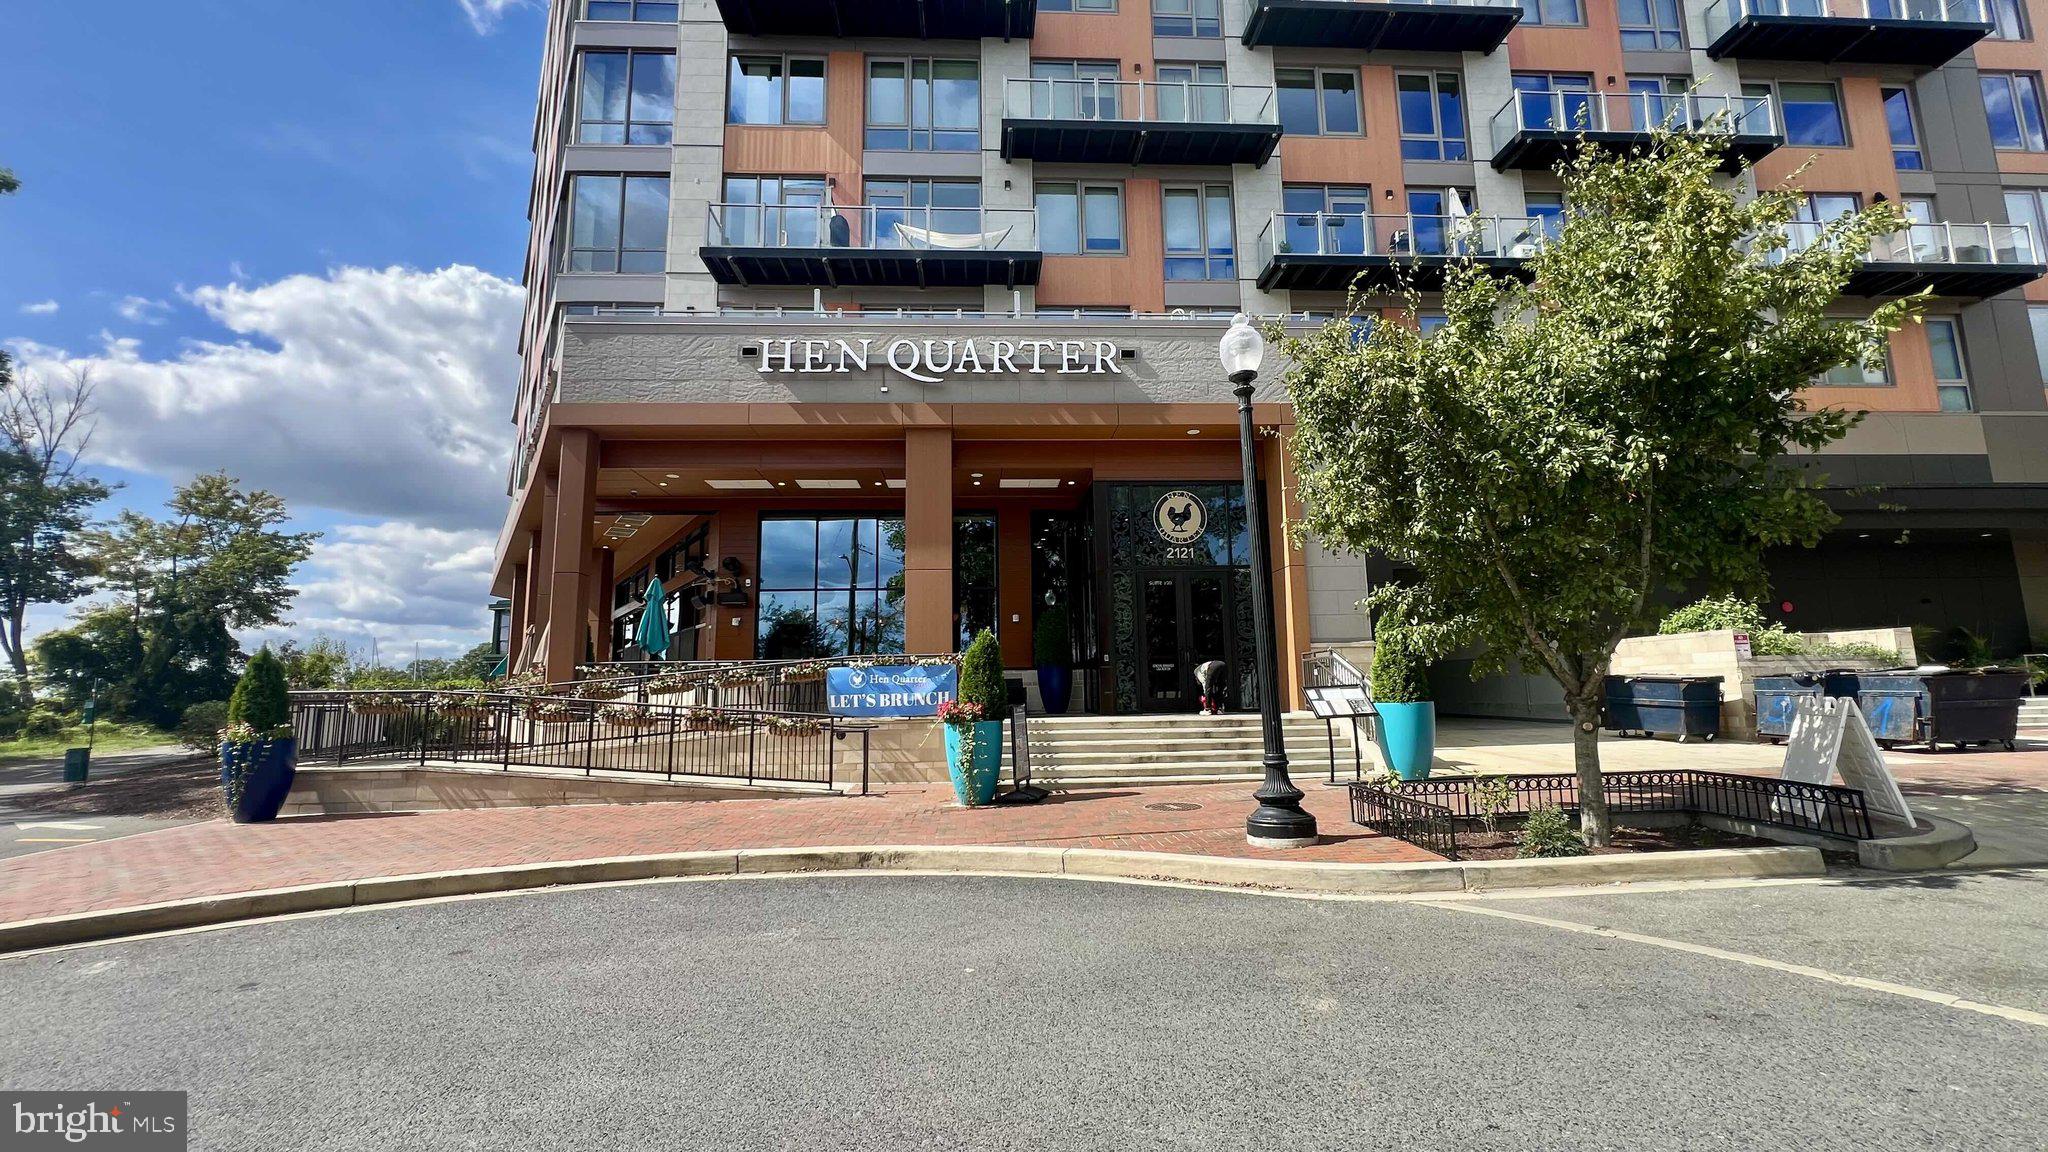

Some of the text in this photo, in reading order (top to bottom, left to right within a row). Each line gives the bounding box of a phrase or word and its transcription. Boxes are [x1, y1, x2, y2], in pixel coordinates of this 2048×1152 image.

[757, 338, 1122, 383] HEN QUARTER
[1166, 547, 1194, 559] 2121
[870, 674, 927, 686] Hen Quarter
[830, 691, 951, 708] LET'S BRUNCH
